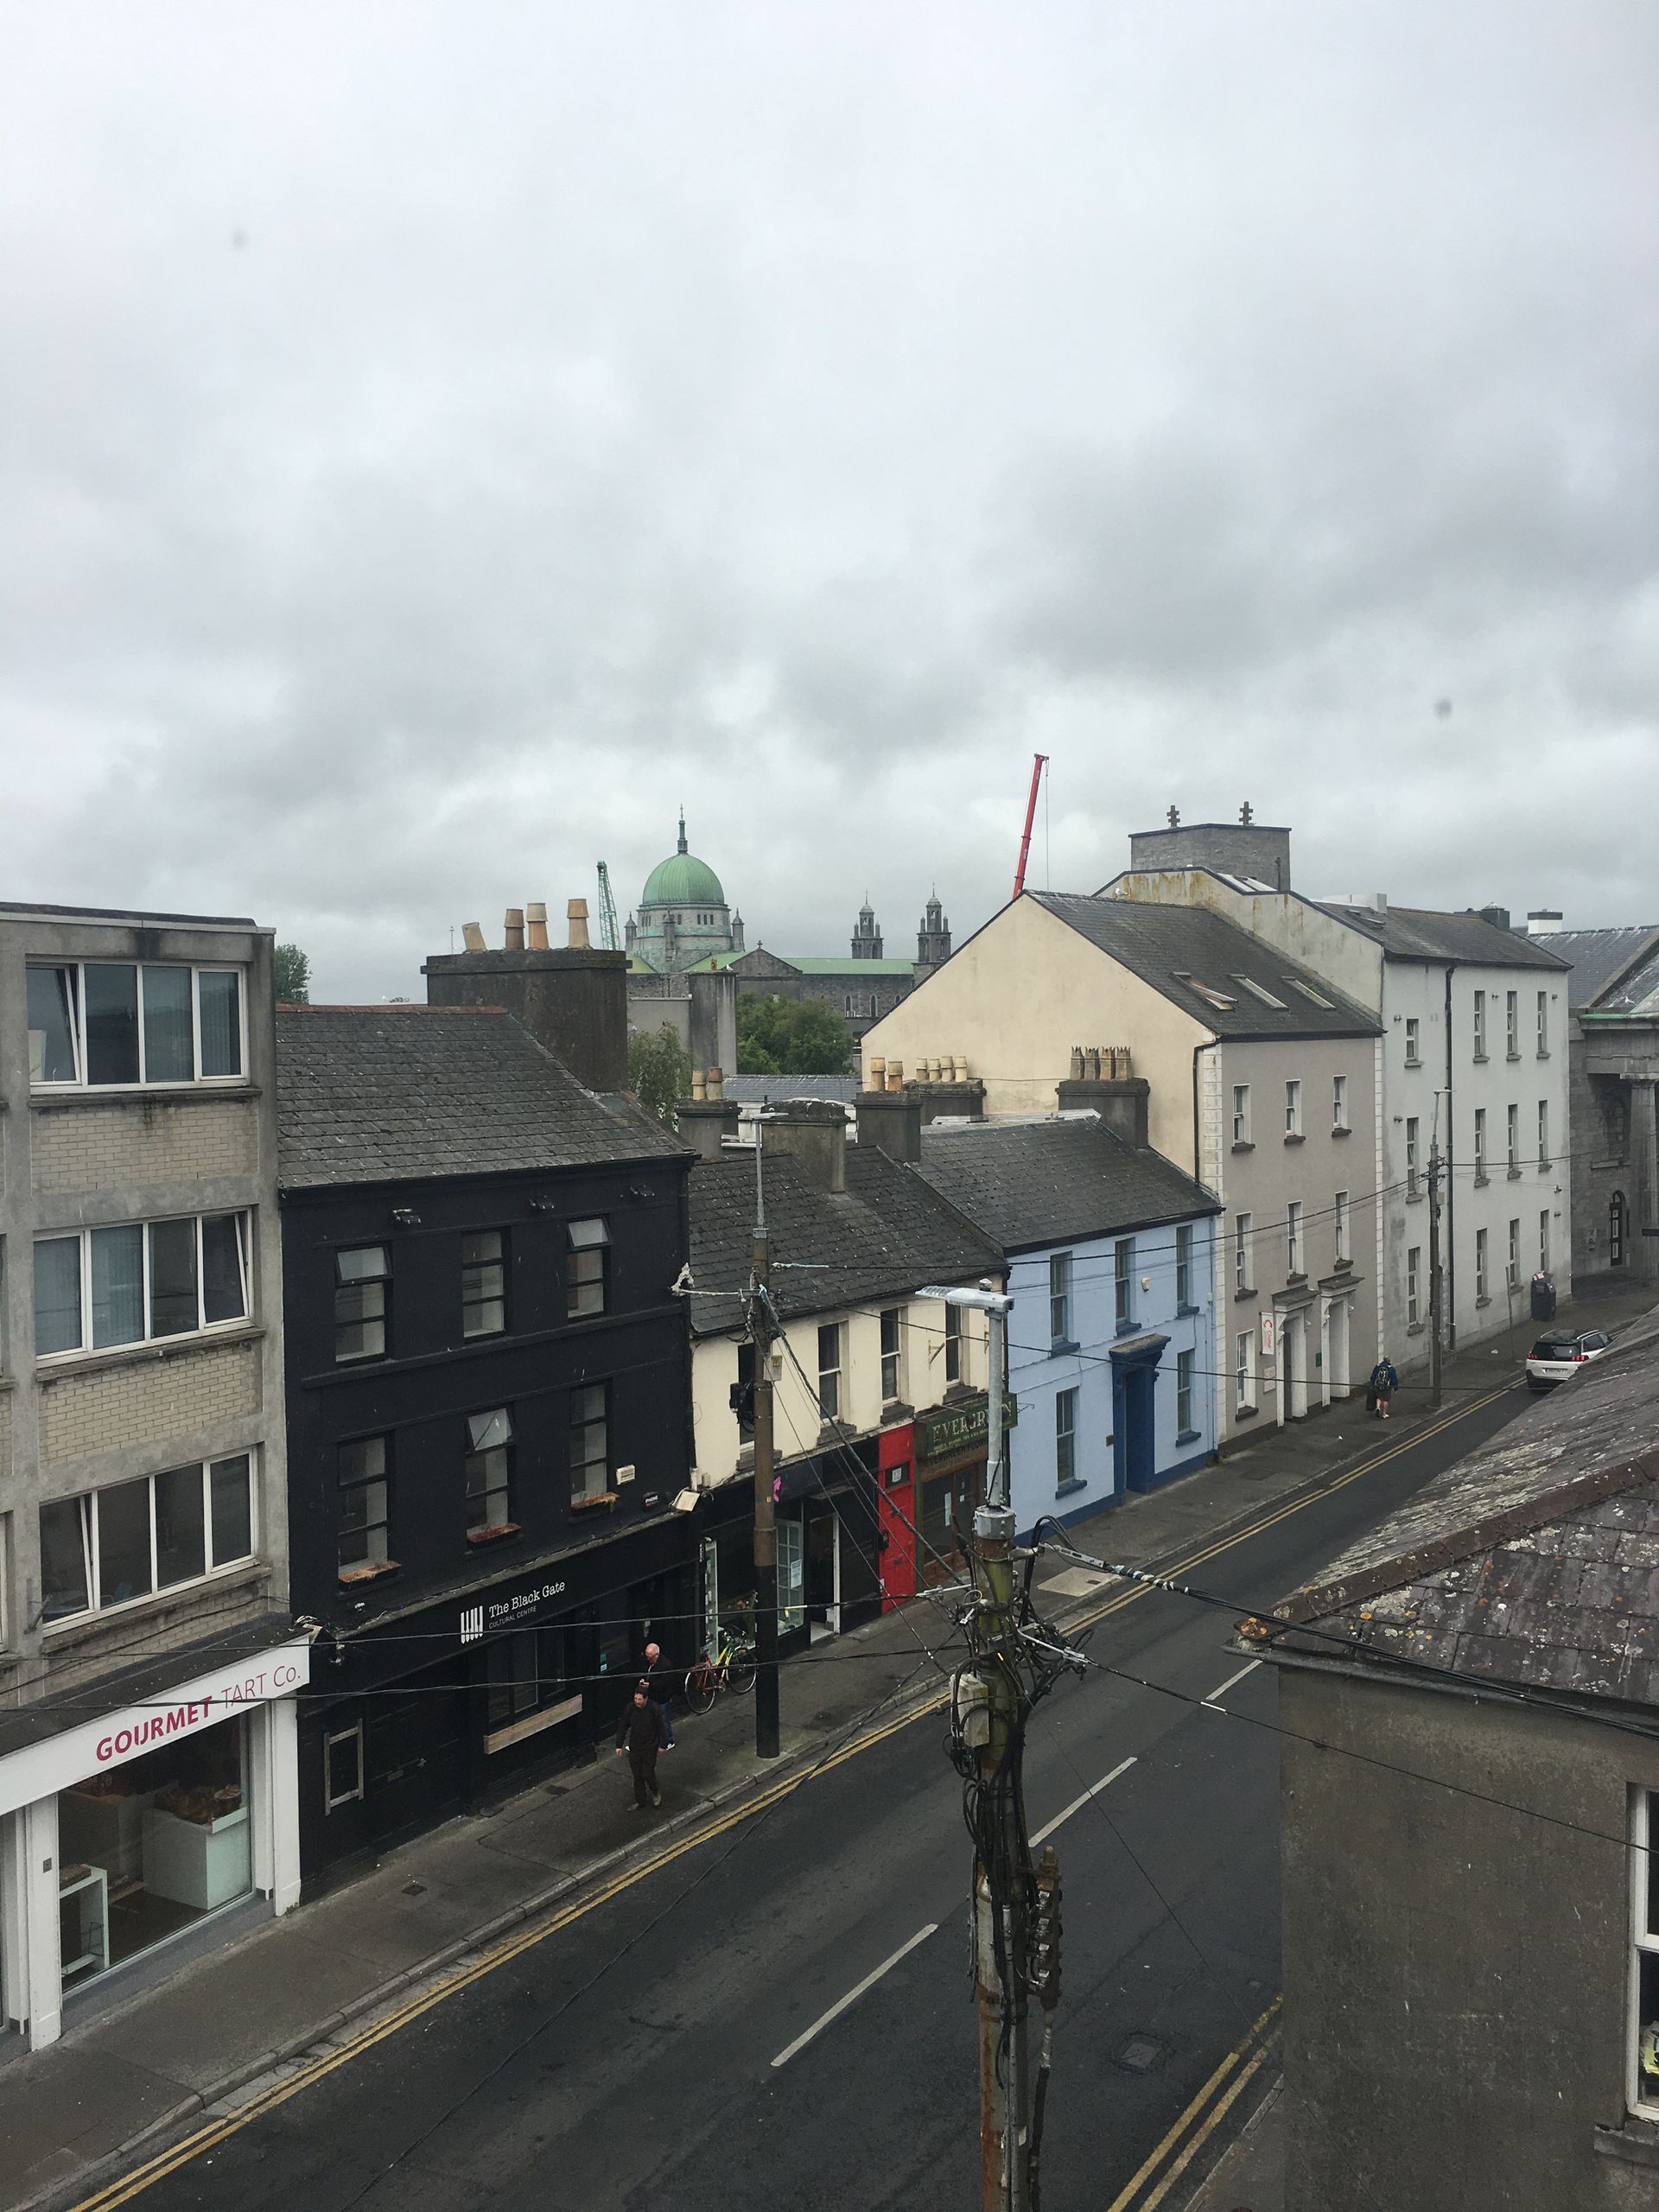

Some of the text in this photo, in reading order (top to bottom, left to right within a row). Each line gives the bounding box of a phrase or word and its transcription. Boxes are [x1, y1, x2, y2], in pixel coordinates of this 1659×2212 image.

[932, 1401, 1012, 1443] EVERGRN
[489, 1581, 566, 1618] The Black Gate
[489, 1605, 537, 1630] CULTURAL CENTRE
[96, 1665, 302, 1762] GOURMET TART Co.
